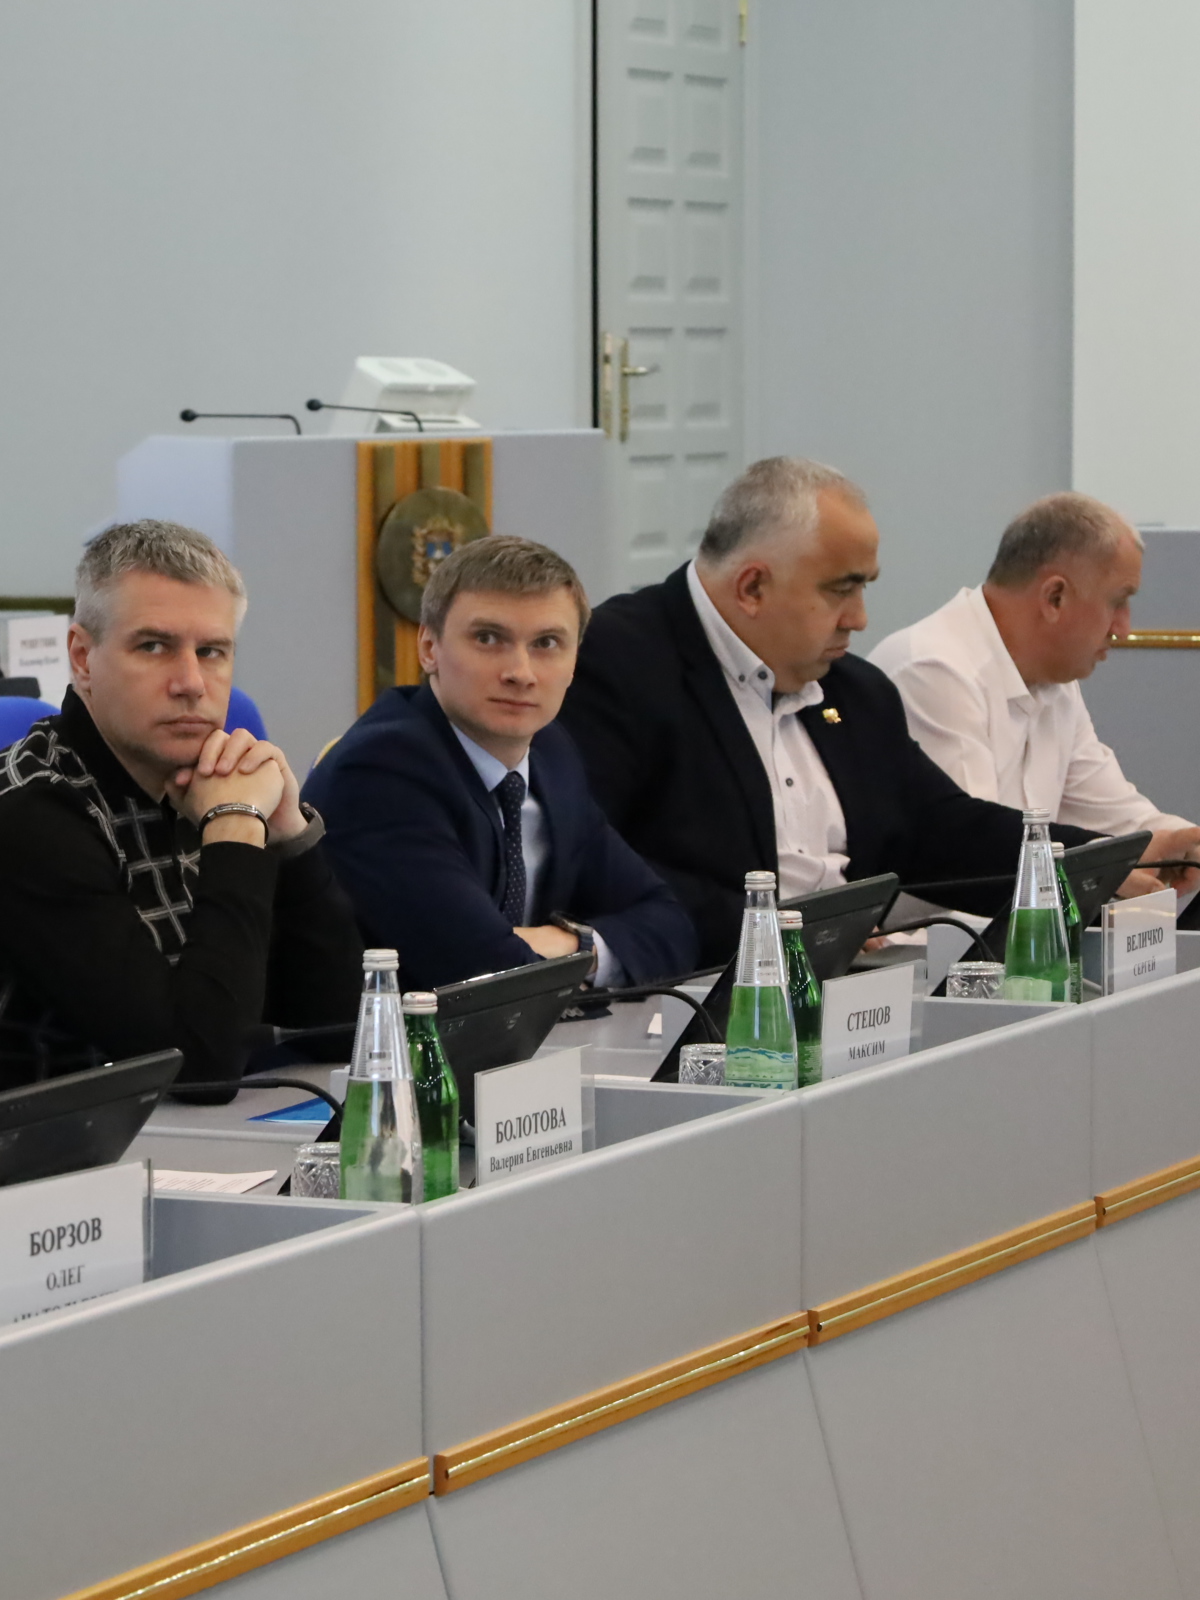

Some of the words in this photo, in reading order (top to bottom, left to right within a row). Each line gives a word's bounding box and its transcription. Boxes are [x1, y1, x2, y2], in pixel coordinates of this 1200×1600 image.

[1126, 926, 1164, 953] ВЕЛИЧКО
[1133, 955, 1156, 977] СЕРГЕЙ
[847, 1005, 891, 1032] СТЕЦОВ
[848, 1040, 886, 1061] МАКСИМ
[495, 1106, 567, 1145] БОЛОТОВА
[490, 1152, 524, 1173] Валерия
[526, 1139, 573, 1163] Евгеньевна
[30, 1217, 103, 1258] БОРЗОВ
[46, 1264, 86, 1291] ОЛЕГ
